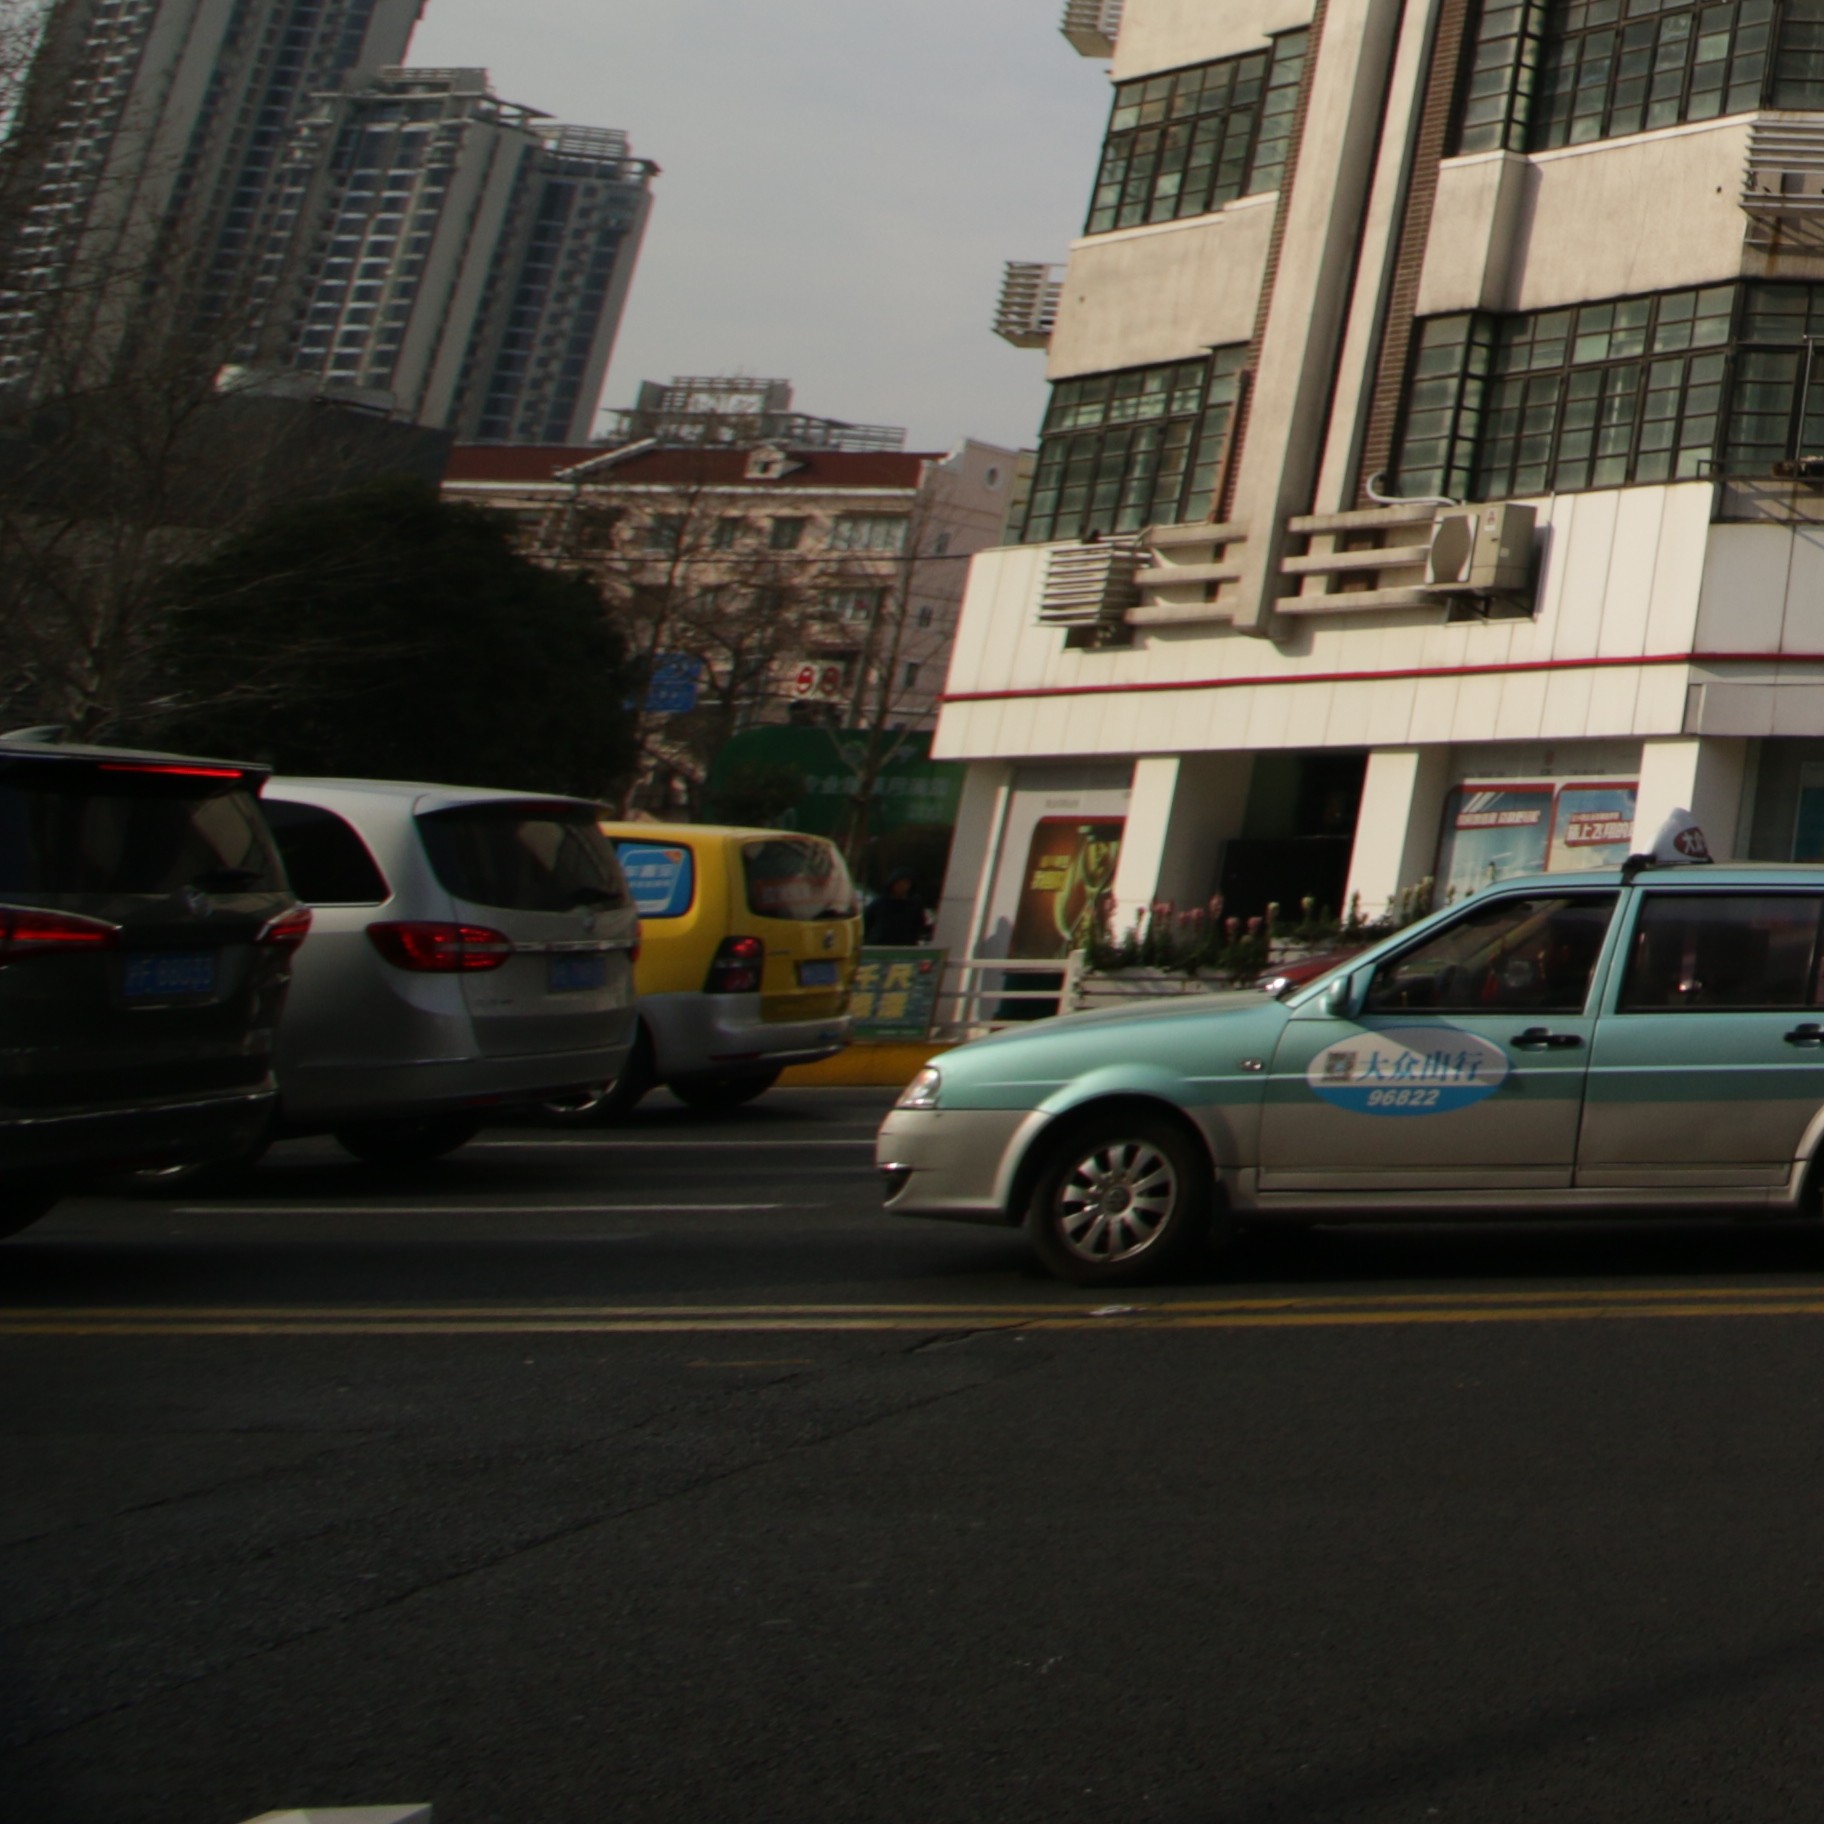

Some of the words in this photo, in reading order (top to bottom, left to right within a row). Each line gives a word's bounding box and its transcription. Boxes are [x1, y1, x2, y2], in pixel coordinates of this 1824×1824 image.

[1356, 1050, 1484, 1083] 大众出行
[1366, 1088, 1441, 1107] 96822
